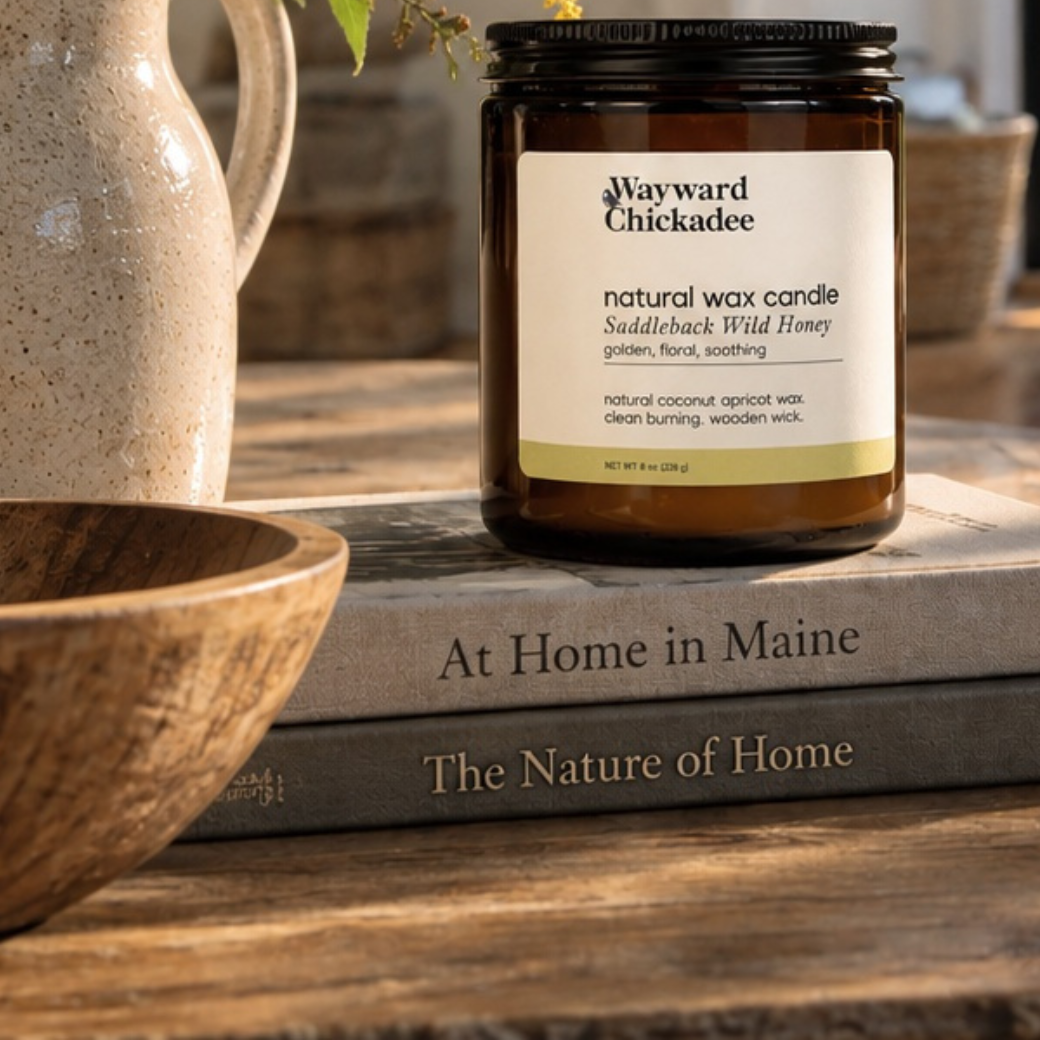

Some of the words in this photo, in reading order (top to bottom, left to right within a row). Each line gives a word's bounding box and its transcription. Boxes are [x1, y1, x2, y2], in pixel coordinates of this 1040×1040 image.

[609, 175, 748, 206] Wayward
[604, 206, 755, 232] Chickadee
[604, 285, 694, 308] natural
[702, 290, 756, 308] wax
[763, 283, 840, 308] candle
[603, 315, 715, 335] Saddleback
[722, 314, 771, 335] Wild
[776, 314, 832, 338] Honey
[603, 343, 656, 359] golden,
[659, 342, 701, 359] floral,
[704, 343, 767, 359] soothing
[603, 393, 654, 407] natural
[657, 395, 716, 408] coconut
[720, 393, 772, 410] apricot
[775, 394, 805, 406] wax.
[603, 410, 643, 425] clean
[709, 411, 768, 425] wooden
[770, 409, 804, 423] wick.
[438, 637, 493, 680] At
[510, 632, 648, 676] Home
[665, 625, 706, 666] in
[722, 617, 861, 661] Maine
[423, 750, 505, 795] The
[519, 746, 663, 788] Nature
[676, 735, 721, 778] of
[730, 734, 854, 775] Home
